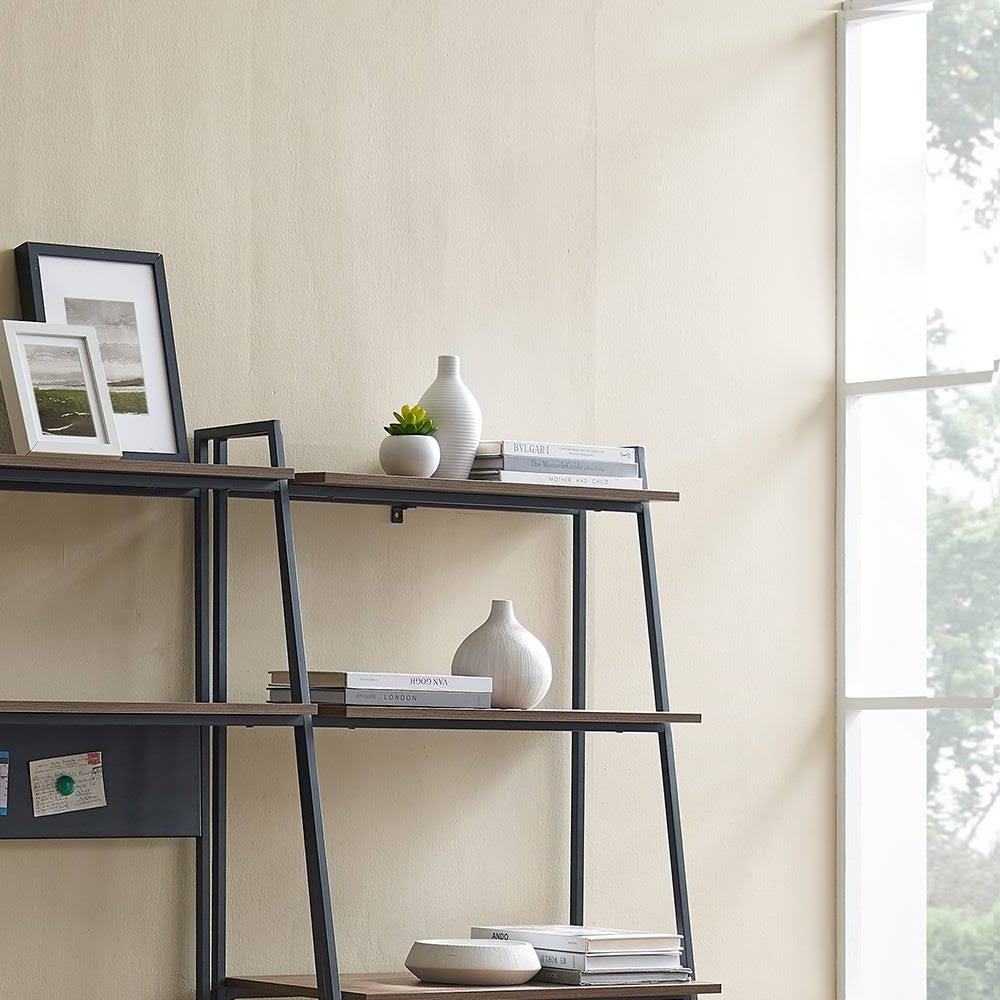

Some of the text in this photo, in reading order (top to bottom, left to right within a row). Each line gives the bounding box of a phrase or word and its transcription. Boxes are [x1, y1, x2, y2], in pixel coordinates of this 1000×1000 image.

[513, 443, 550, 455] BVLGARI
[410, 677, 448, 686] VAN GOGH
[491, 932, 509, 941] ANDO
